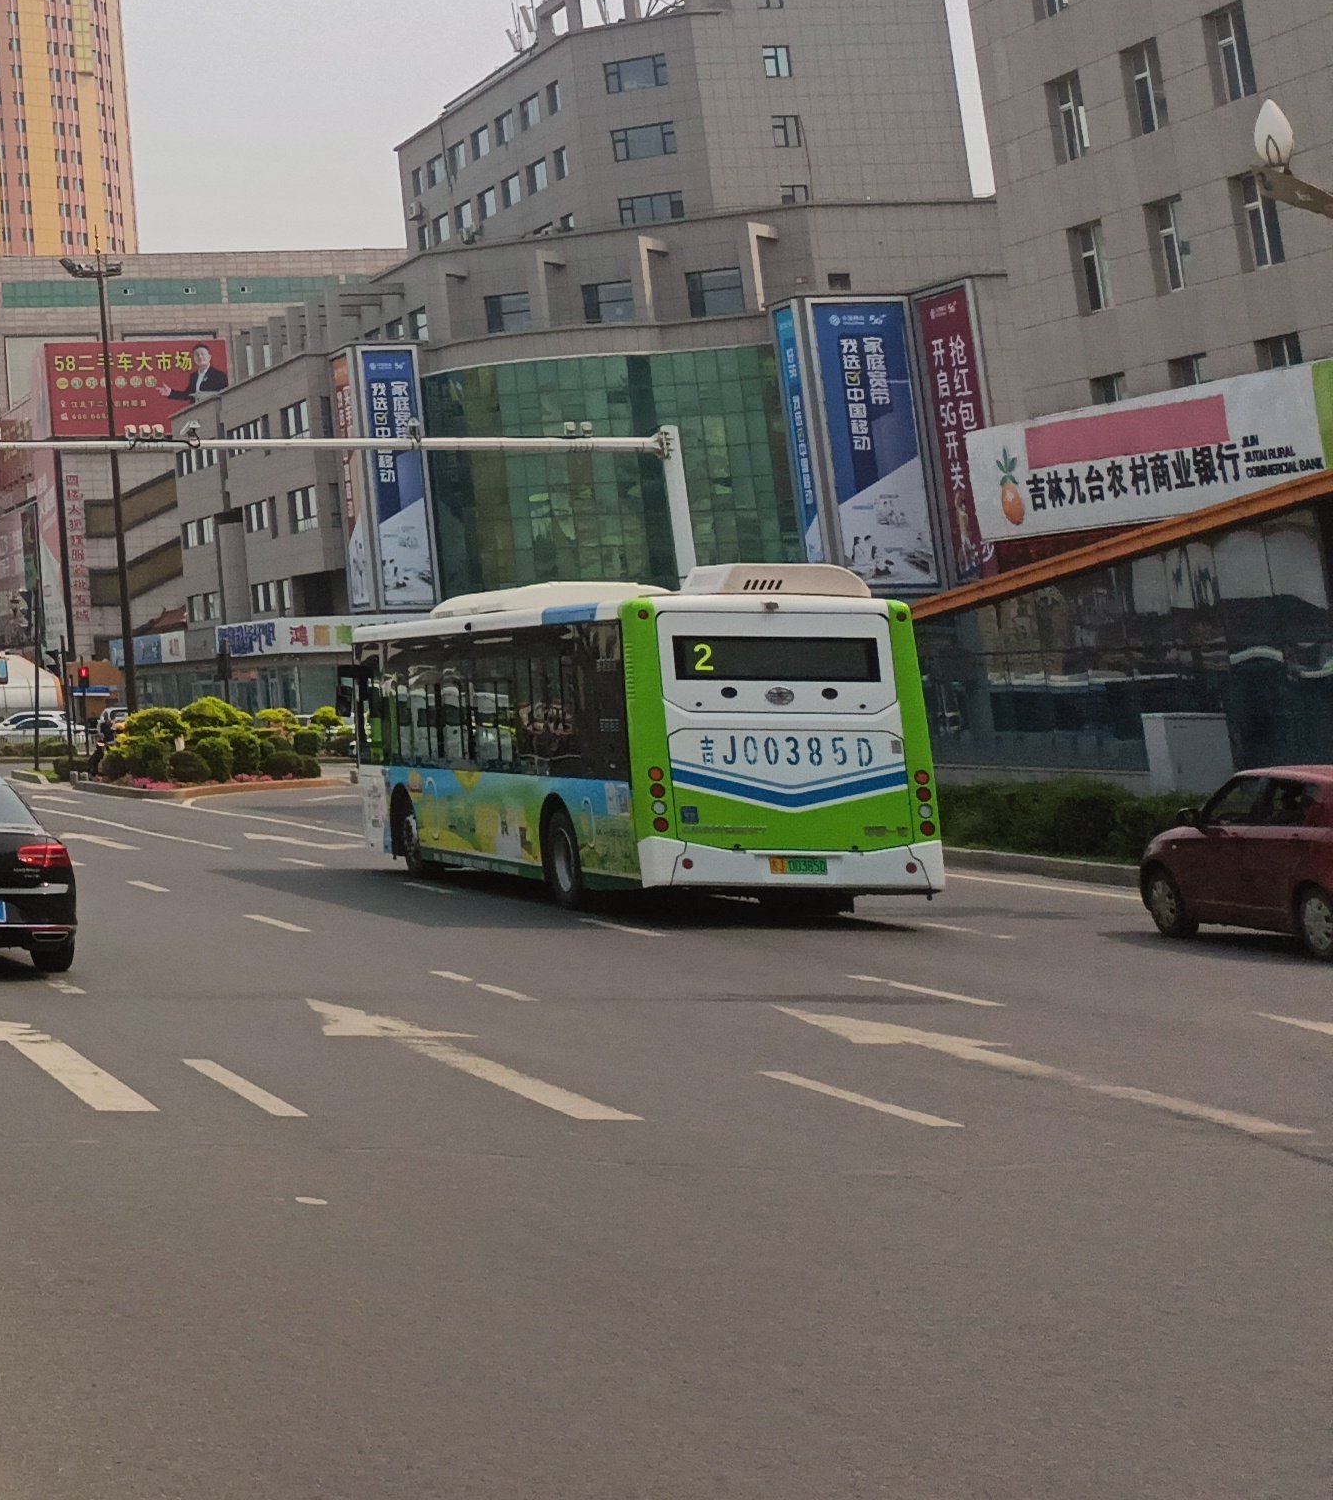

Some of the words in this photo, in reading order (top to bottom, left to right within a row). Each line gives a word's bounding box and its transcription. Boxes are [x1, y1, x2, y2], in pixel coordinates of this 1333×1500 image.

[54, 351, 193, 372] 58二手车大市场
[863, 336, 891, 406] 家庭宽带
[1025, 443, 1241, 512] 吉林九台农村商业银行
[692, 643, 715, 672] 2
